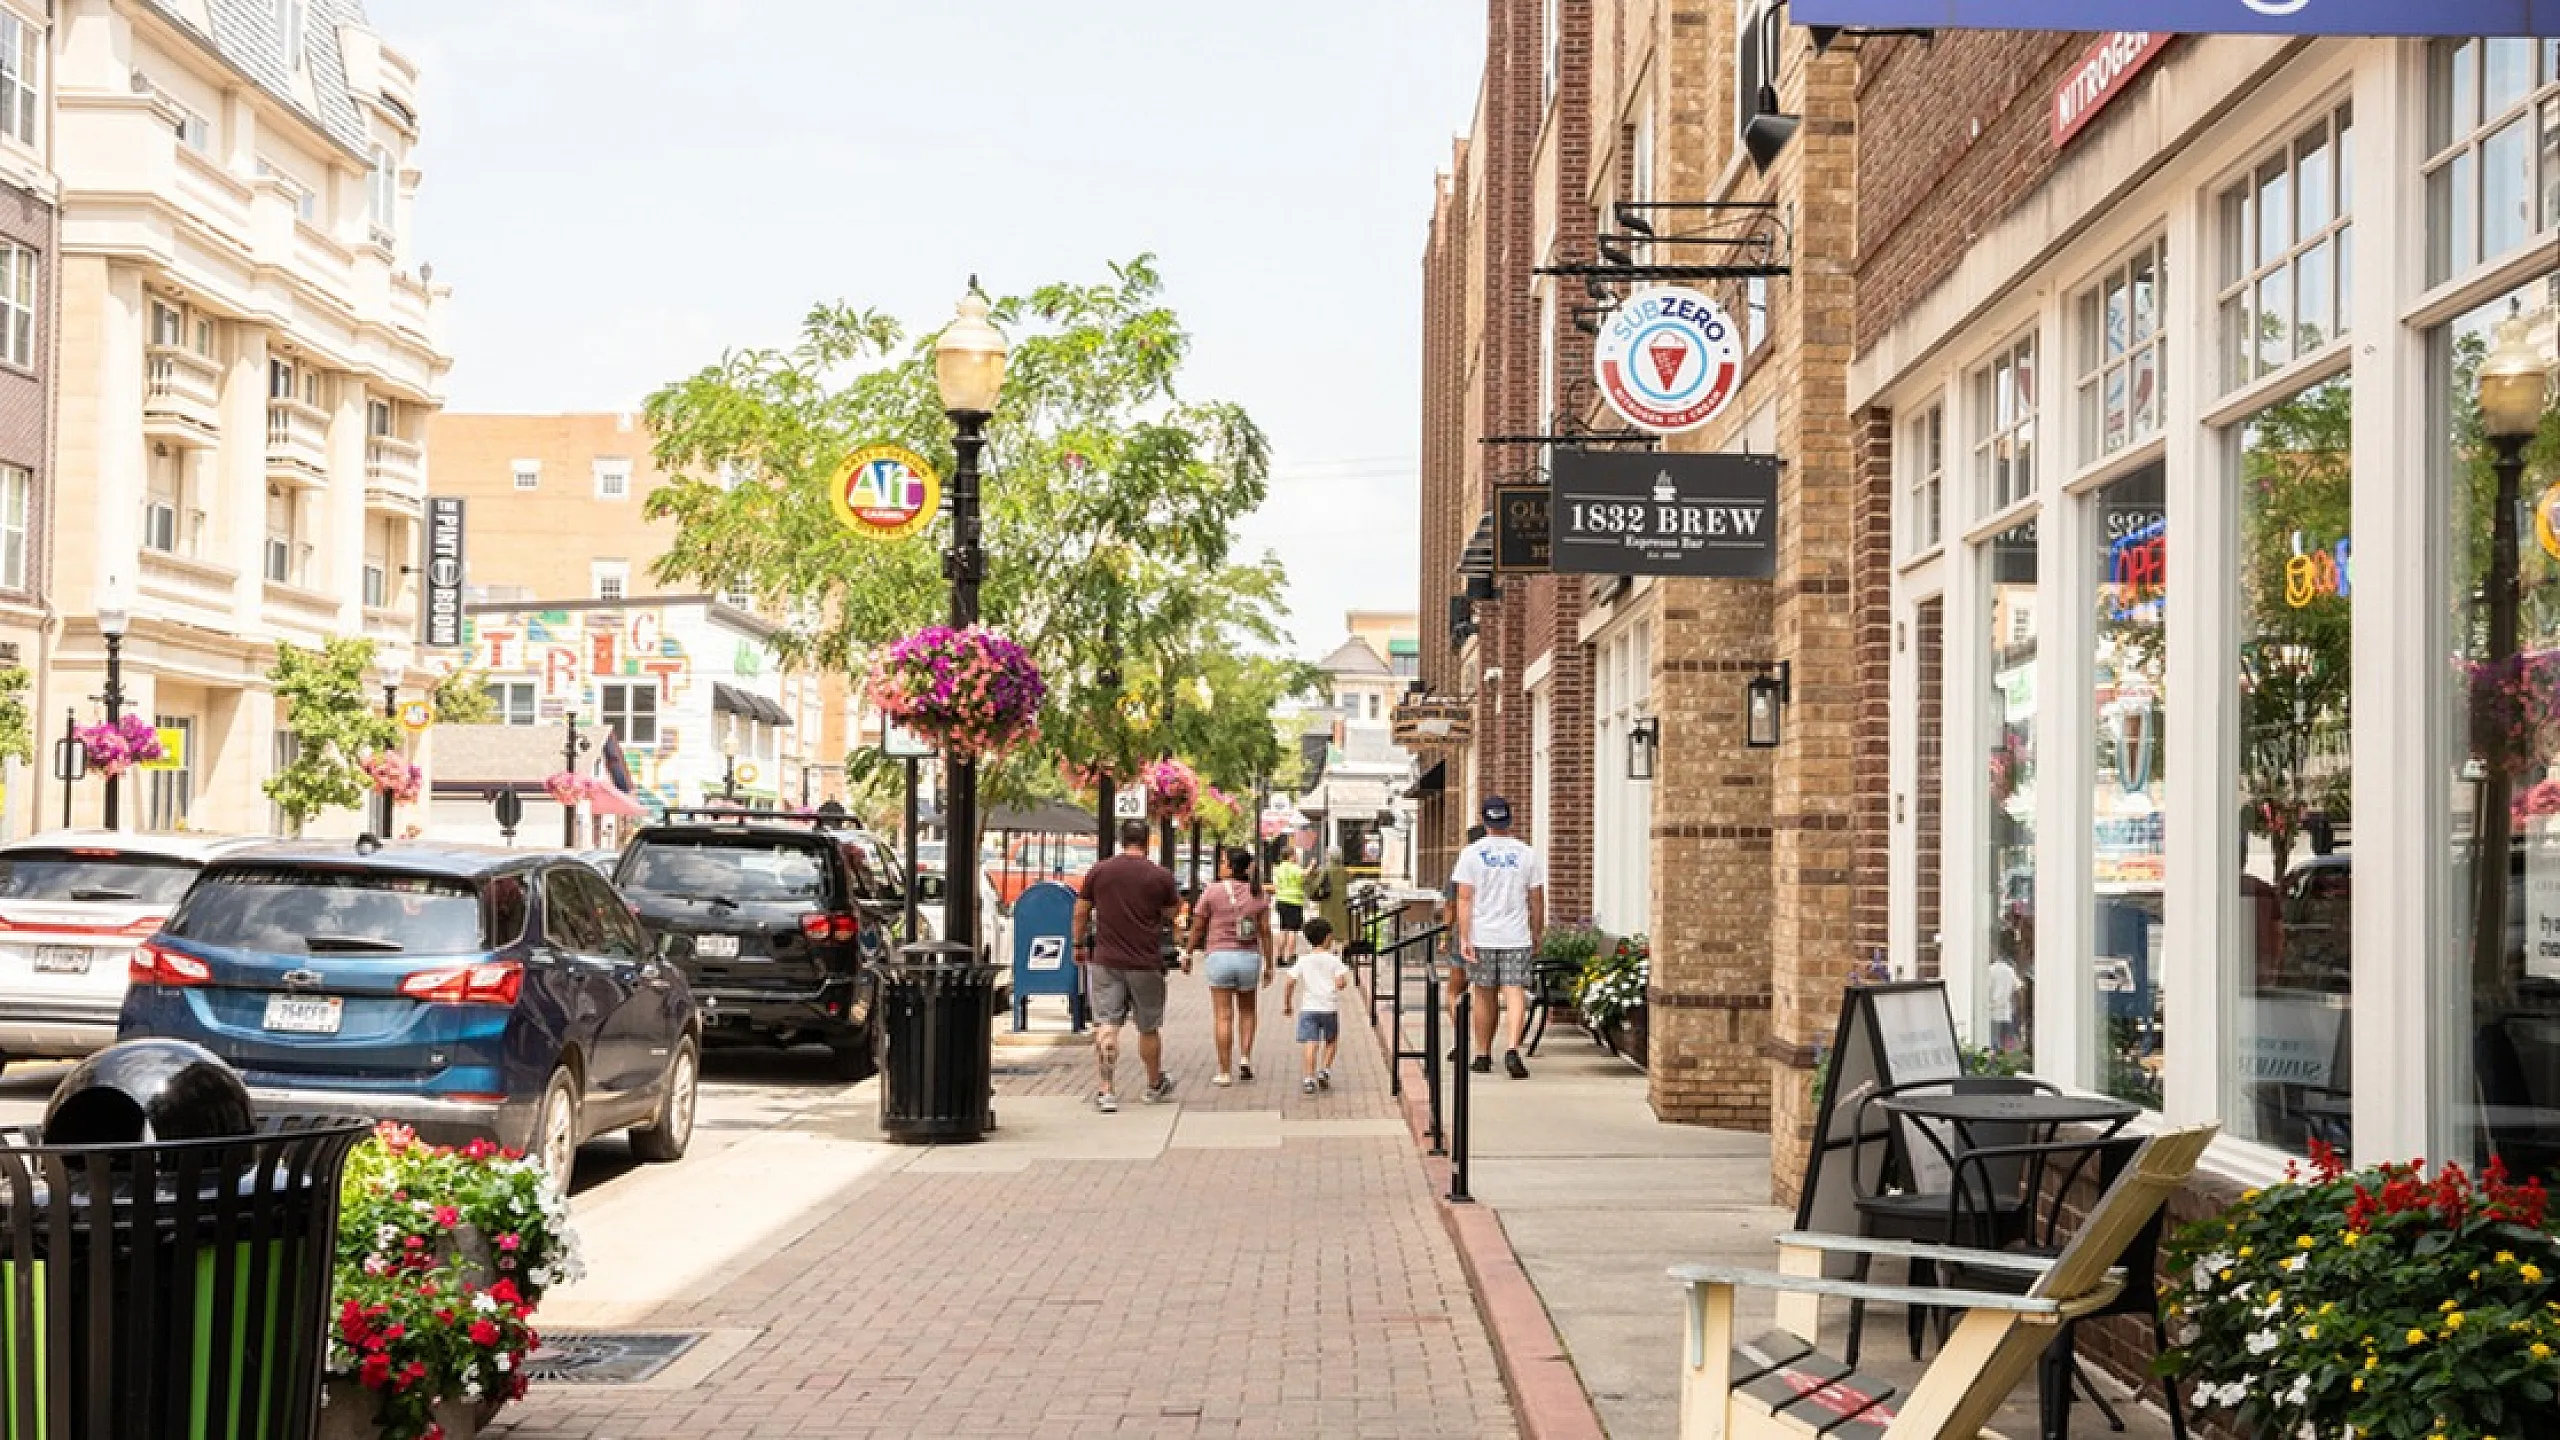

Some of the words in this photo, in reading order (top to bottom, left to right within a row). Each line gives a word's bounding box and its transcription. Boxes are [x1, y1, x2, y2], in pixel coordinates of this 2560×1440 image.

[1570, 503, 1646, 532] 1832
[1655, 506, 1763, 536] BREW
[2119, 537, 2166, 607] OPE
